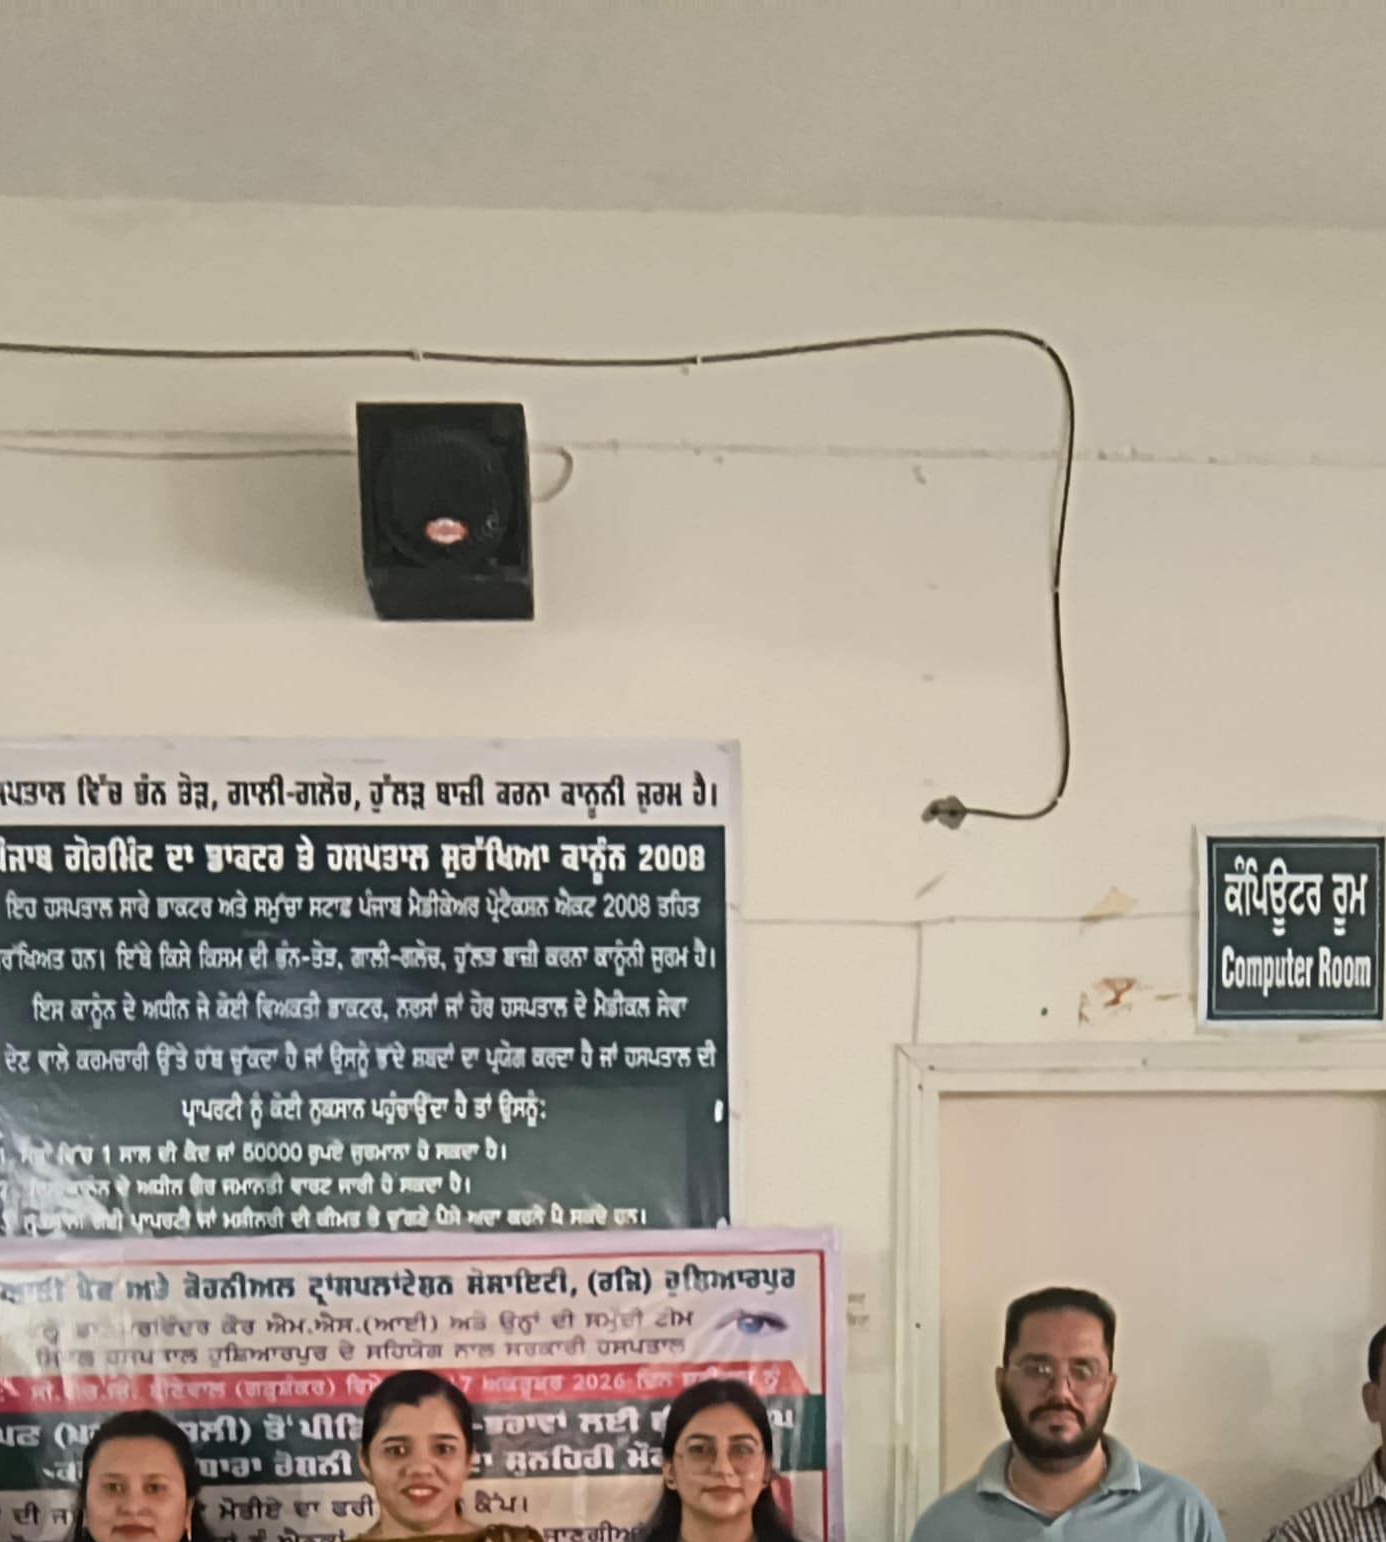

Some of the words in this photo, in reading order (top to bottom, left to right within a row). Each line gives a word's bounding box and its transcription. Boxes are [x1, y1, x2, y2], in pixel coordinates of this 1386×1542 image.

[77, 773, 123, 806] ਵਿੱਚ
[495, 781, 550, 806] ਕਰਨਾ
[164, 844, 195, 873] ਦਾ
[204, 843, 284, 873] ਡਾਕਟਰ
[295, 834, 315, 872] ਤੇ
[326, 843, 430, 872] ਹਸਪਤਾਲ
[638, 844, 706, 872] 2008
[43, 897, 114, 920] ਹਸਪਤਾਲ
[217, 889, 249, 919] ਅਤੇ
[358, 888, 403, 918] ਪੰਜਾਬ
[602, 892, 651, 919] 2008
[1224, 854, 1324, 937] ਕੰਪਿਊਟਰ
[1331, 873, 1369, 937] ਰੂਮ
[1221, 945, 1314, 998] Computer
[1318, 946, 1372, 989] Room
[242, 1141, 303, 1163] 50000
[573, 1374, 625, 1391] 2026
